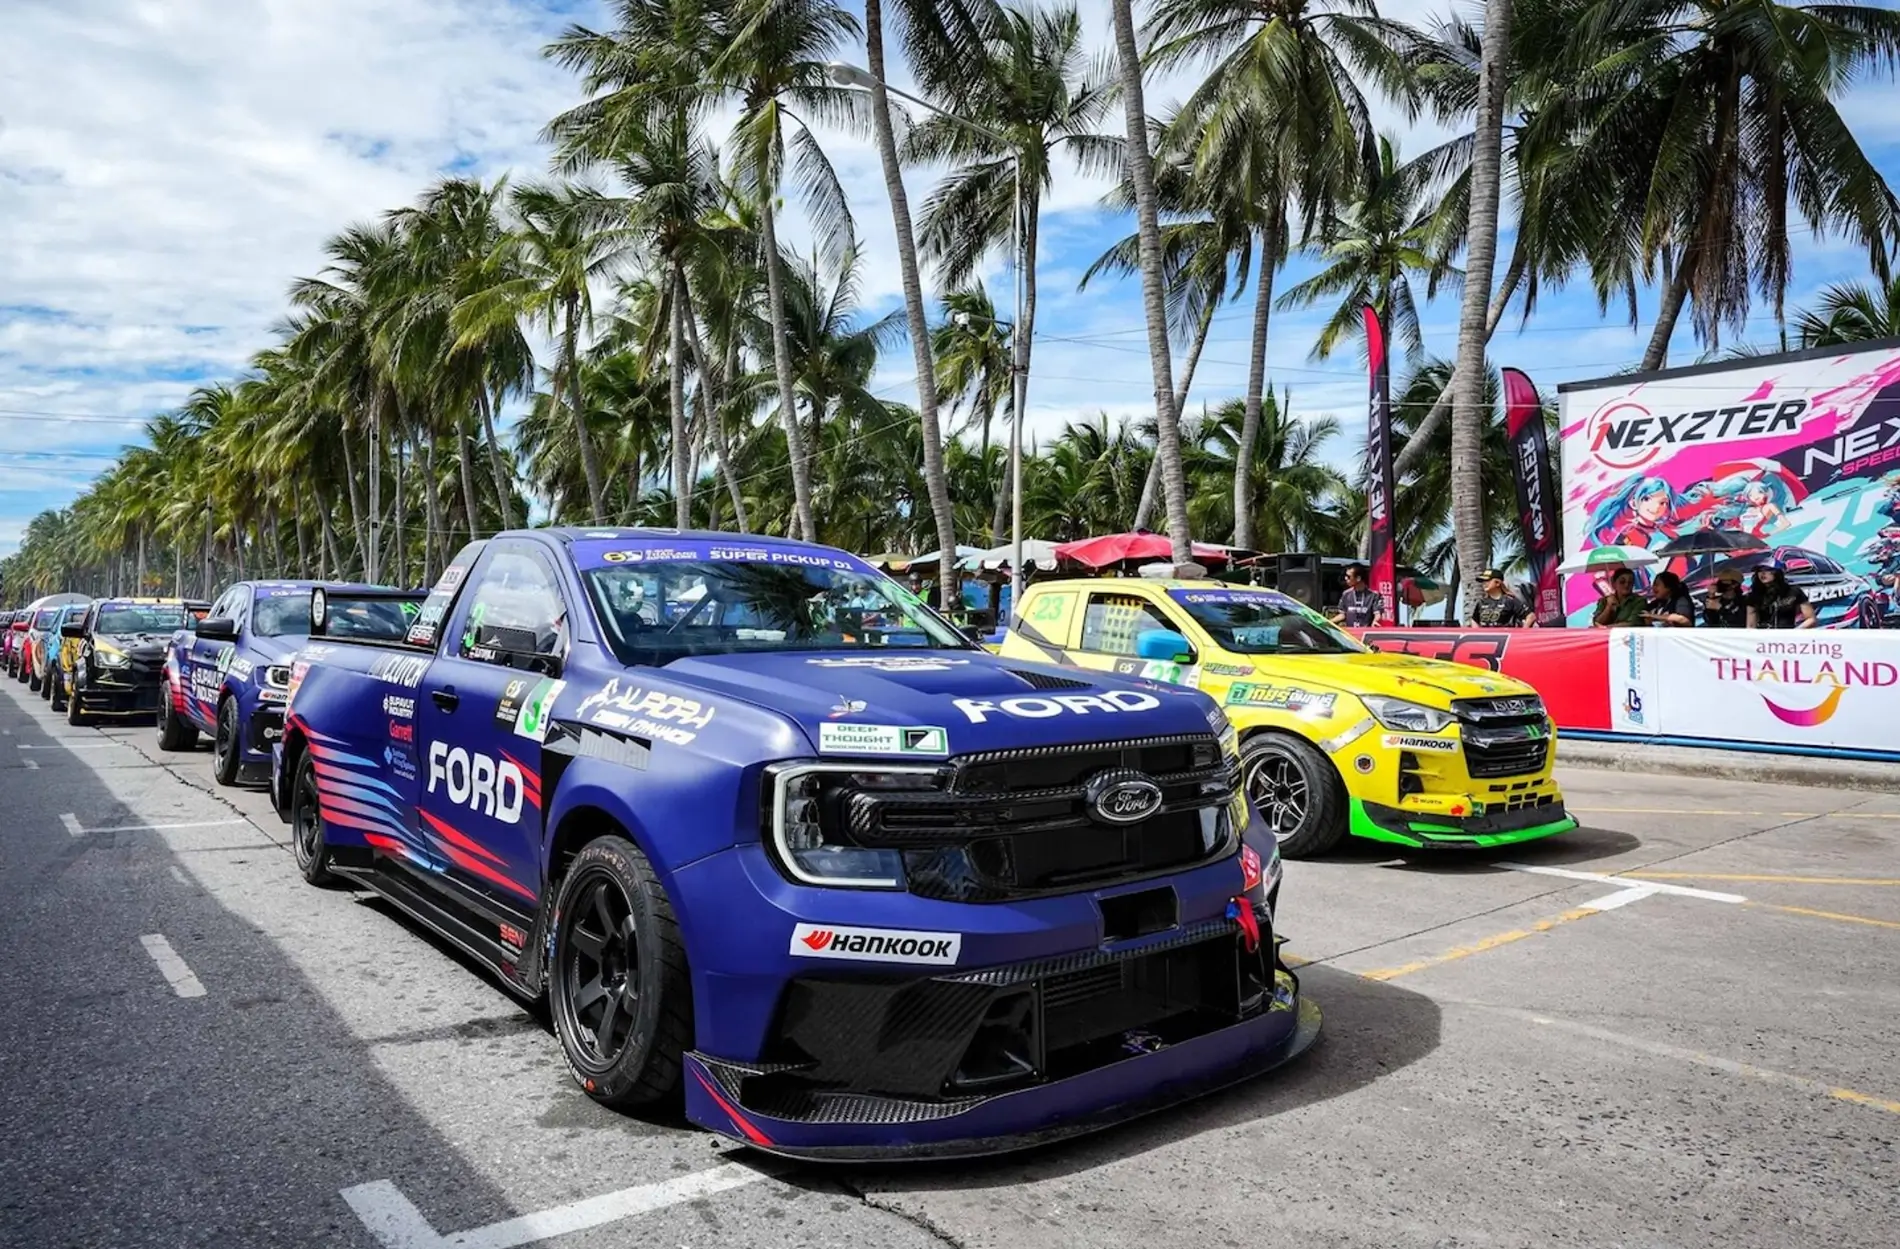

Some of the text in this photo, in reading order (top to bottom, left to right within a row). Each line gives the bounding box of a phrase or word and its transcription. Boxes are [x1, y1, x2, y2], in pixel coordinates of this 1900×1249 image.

[1590, 398, 1808, 452] NEXZTER
[709, 549, 854, 570] SUPER PICKUP D1
[1034, 595, 1064, 622] 23
[1756, 640, 1843, 659] amazing
[1709, 656, 1898, 687] THAILAND
[952, 690, 1160, 724] FORD
[389, 719, 412, 742] Garrett
[823, 734, 893, 743] THOUGHT
[837, 725, 878, 733] DEEP
[427, 739, 524, 824] FORD
[1115, 788, 1149, 813] Ford
